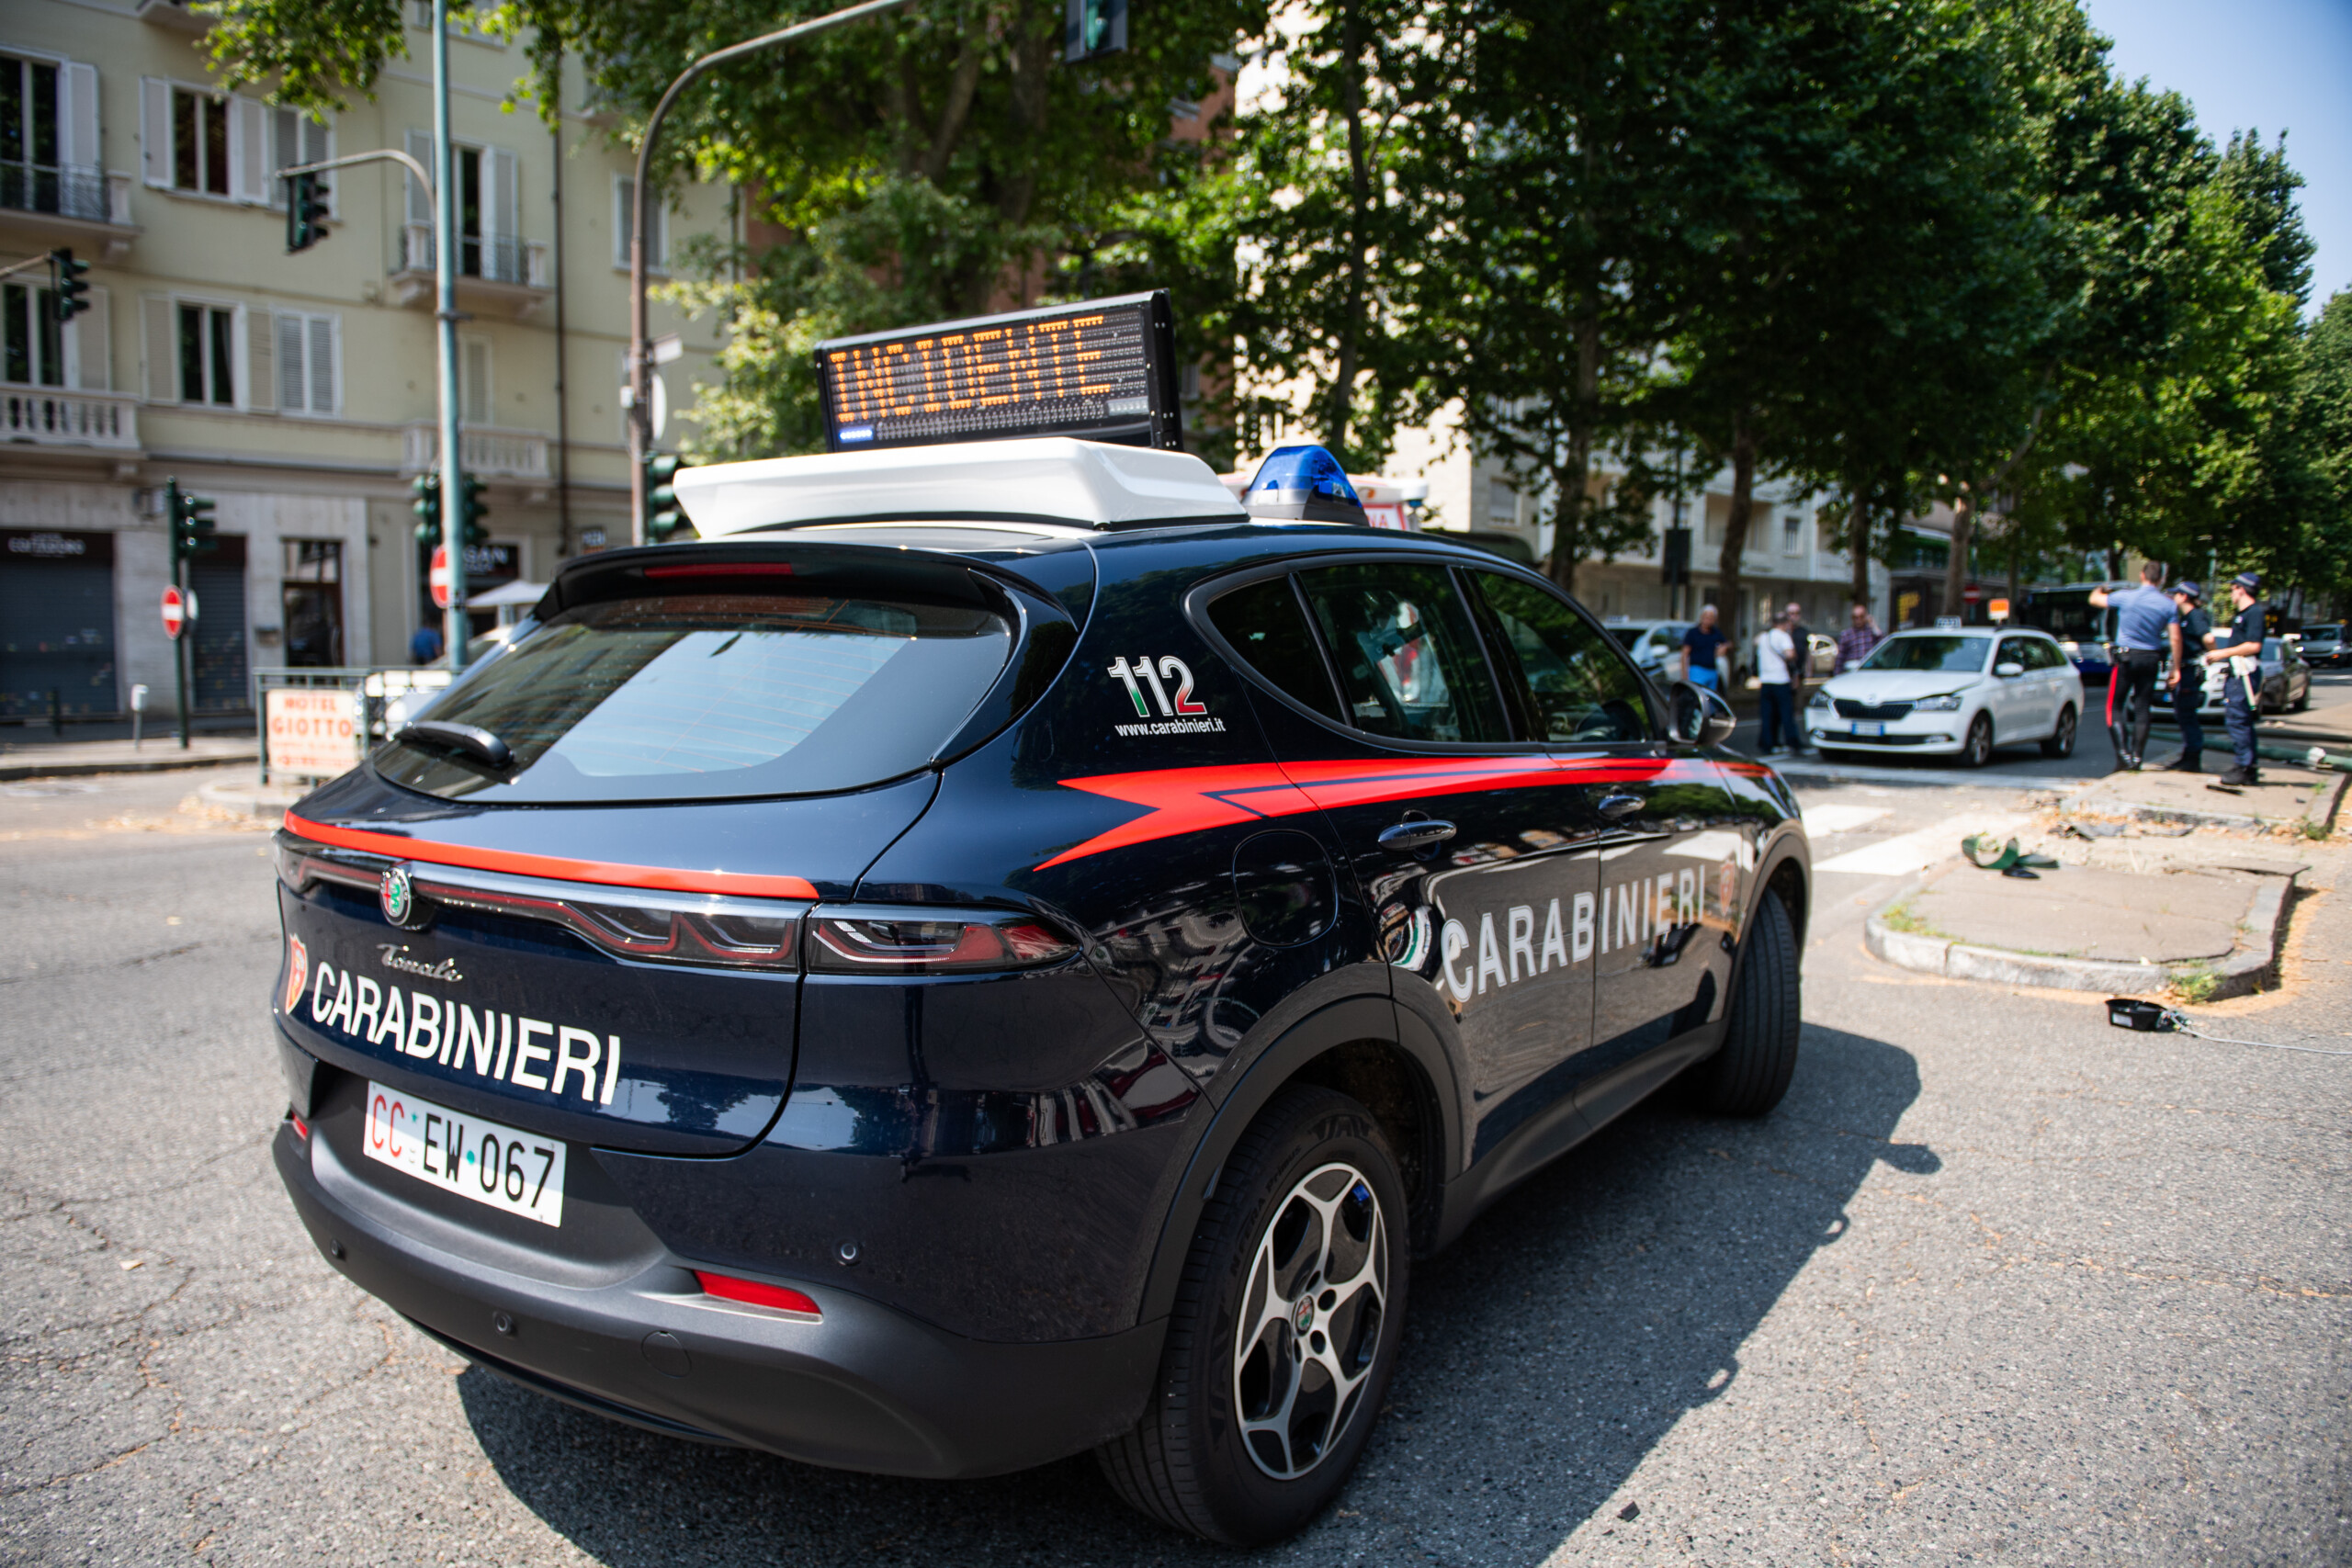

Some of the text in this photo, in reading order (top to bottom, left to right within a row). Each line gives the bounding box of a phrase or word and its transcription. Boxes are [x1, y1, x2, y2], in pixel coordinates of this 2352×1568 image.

[831, 316, 1111, 423] INCIDENTE
[283, 697, 337, 712] HOTEL
[1107, 655, 1208, 717] 112
[272, 716, 353, 739] GIOTTO
[1114, 716, 1227, 737] www.carabinieri.it
[377, 943, 463, 982] Tonale
[1441, 864, 1705, 1002] CARABINIERI
[312, 962, 620, 1105] CARABINIERI
[372, 1094, 555, 1209] CC EW 067
